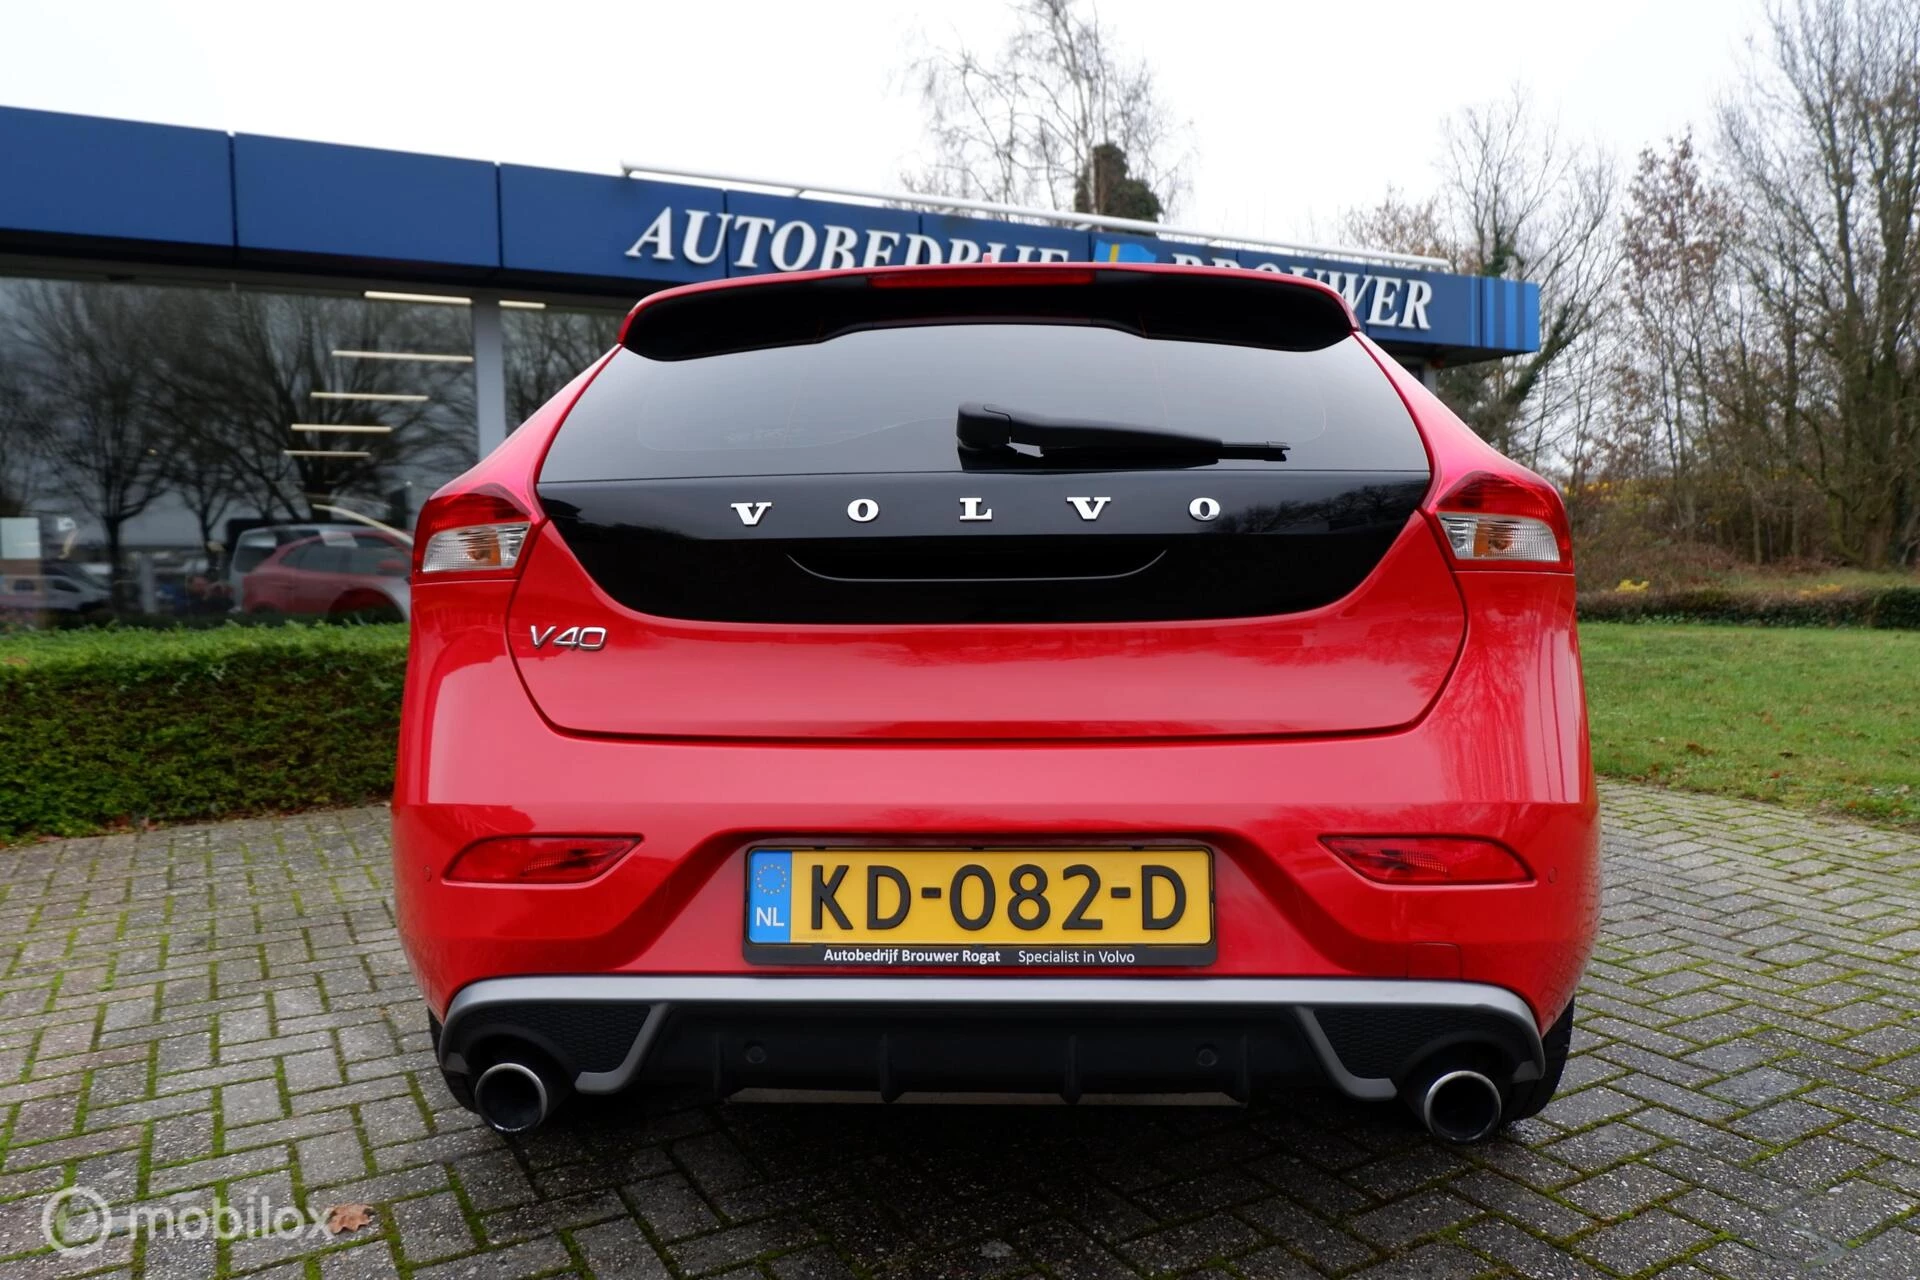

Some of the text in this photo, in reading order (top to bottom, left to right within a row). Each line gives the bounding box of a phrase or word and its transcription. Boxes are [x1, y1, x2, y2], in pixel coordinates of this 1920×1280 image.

[731, 495, 1222, 526] VOLVO
[530, 624, 607, 650] V40
[811, 864, 1187, 931] KD-082-D
[756, 906, 785, 927] NL
[824, 949, 1135, 965] Autobedrijf Brouwer Rogat Specialist in Volvo
